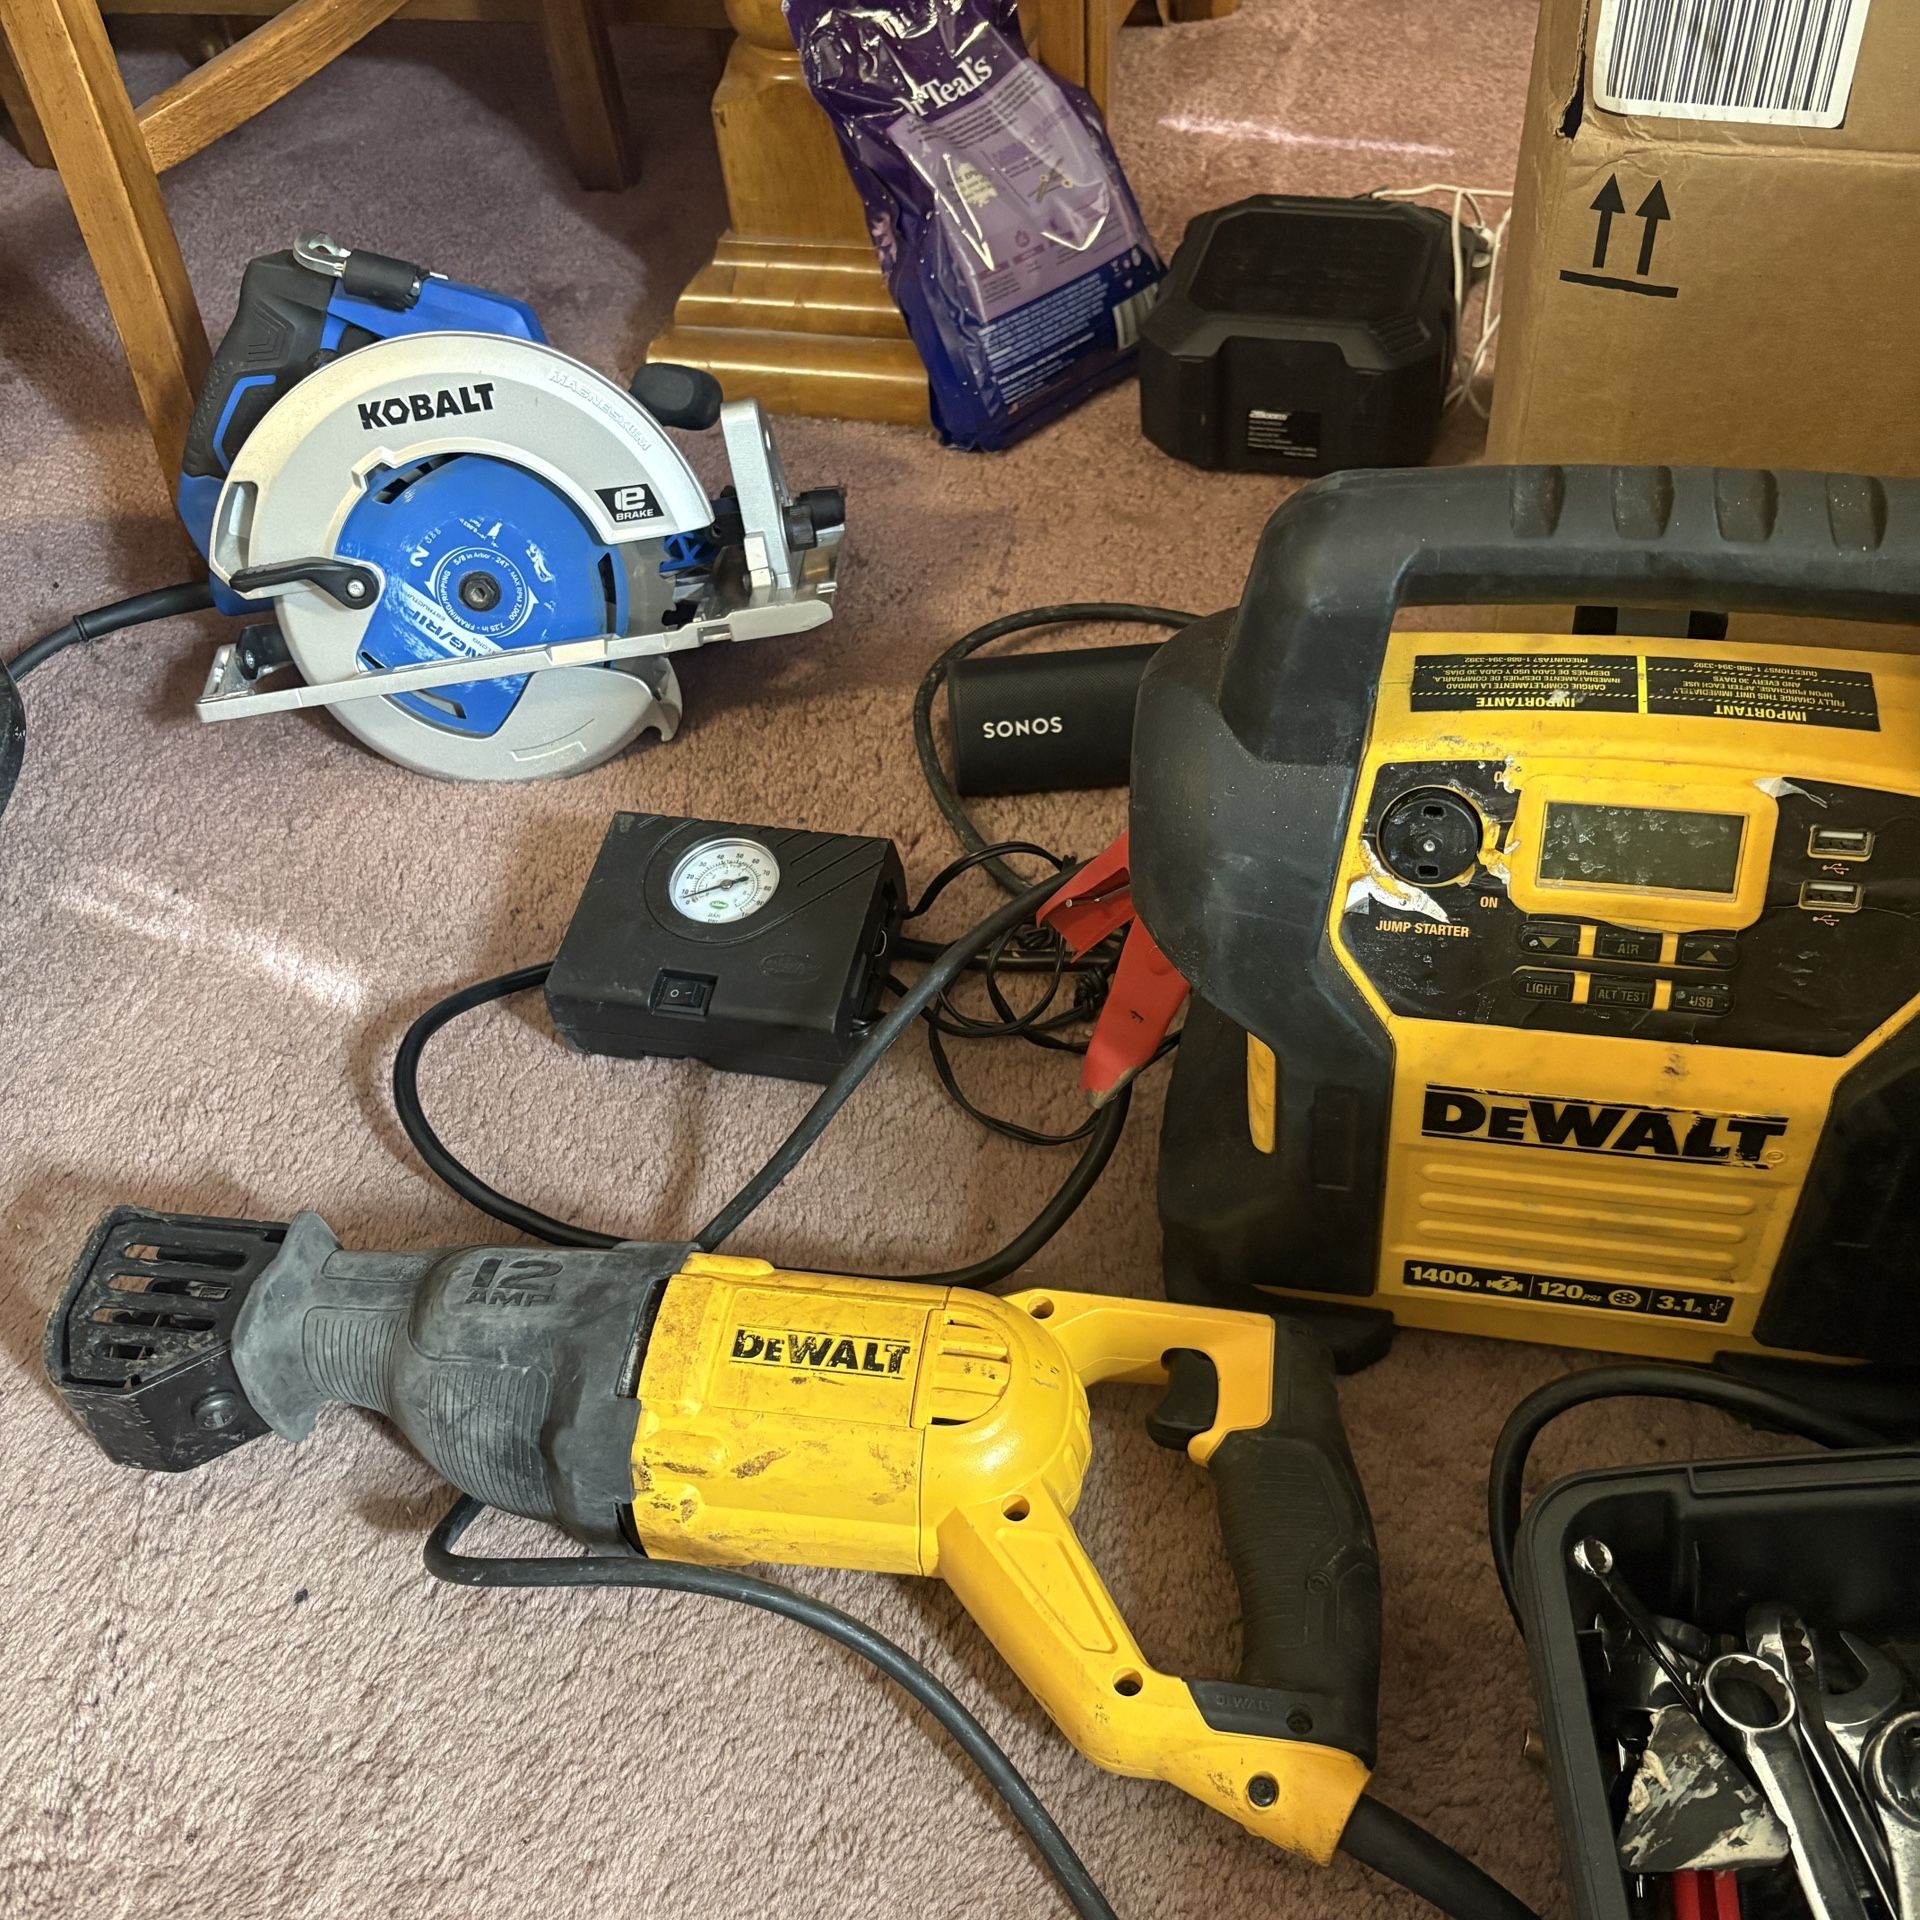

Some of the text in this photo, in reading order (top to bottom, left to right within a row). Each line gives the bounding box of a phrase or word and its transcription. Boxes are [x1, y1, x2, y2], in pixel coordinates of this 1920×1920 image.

[919, 56, 993, 109] Teal's
[358, 382, 495, 430] KOBALT
[549, 367, 652, 451] MAGNESIUM
[615, 509, 655, 522] BRAKE
[453, 554, 467, 566] 5/8
[473, 551, 491, 560] Arbor
[495, 556, 511, 569] 24T
[510, 571, 521, 584] MAX
[440, 569, 476, 631] FRAMING/RIPPING
[489, 622, 506, 633] 7.25
[1712, 675, 1737, 683] DAYS
[1764, 667, 1818, 677] QUESTIONS?
[1543, 675, 1621, 684] INMEDIATAMENTE
[1682, 680, 1700, 688] USE
[1751, 679, 1780, 687] EVERY
[1572, 683, 1606, 691] CARGUE
[1808, 689, 1834, 698] UPON
[1475, 696, 1576, 708] IMPORTANTE
[1672, 687, 1845, 708] FULLY CHARGE THIS UNIT IMMEDIATELY
[1713, 704, 1807, 722] IMPORTANT
[982, 716, 1063, 739] SONOS
[1479, 895, 1498, 909] ON
[1375, 919, 1470, 938] JUMP STARTER
[1617, 943, 1641, 955] AIR
[1525, 982, 1560, 996] LIGHT
[1598, 988, 1646, 1003] ALT TEST
[1690, 995, 1714, 1009] USB
[472, 1256, 564, 1291] 12
[464, 1286, 550, 1307] AMP
